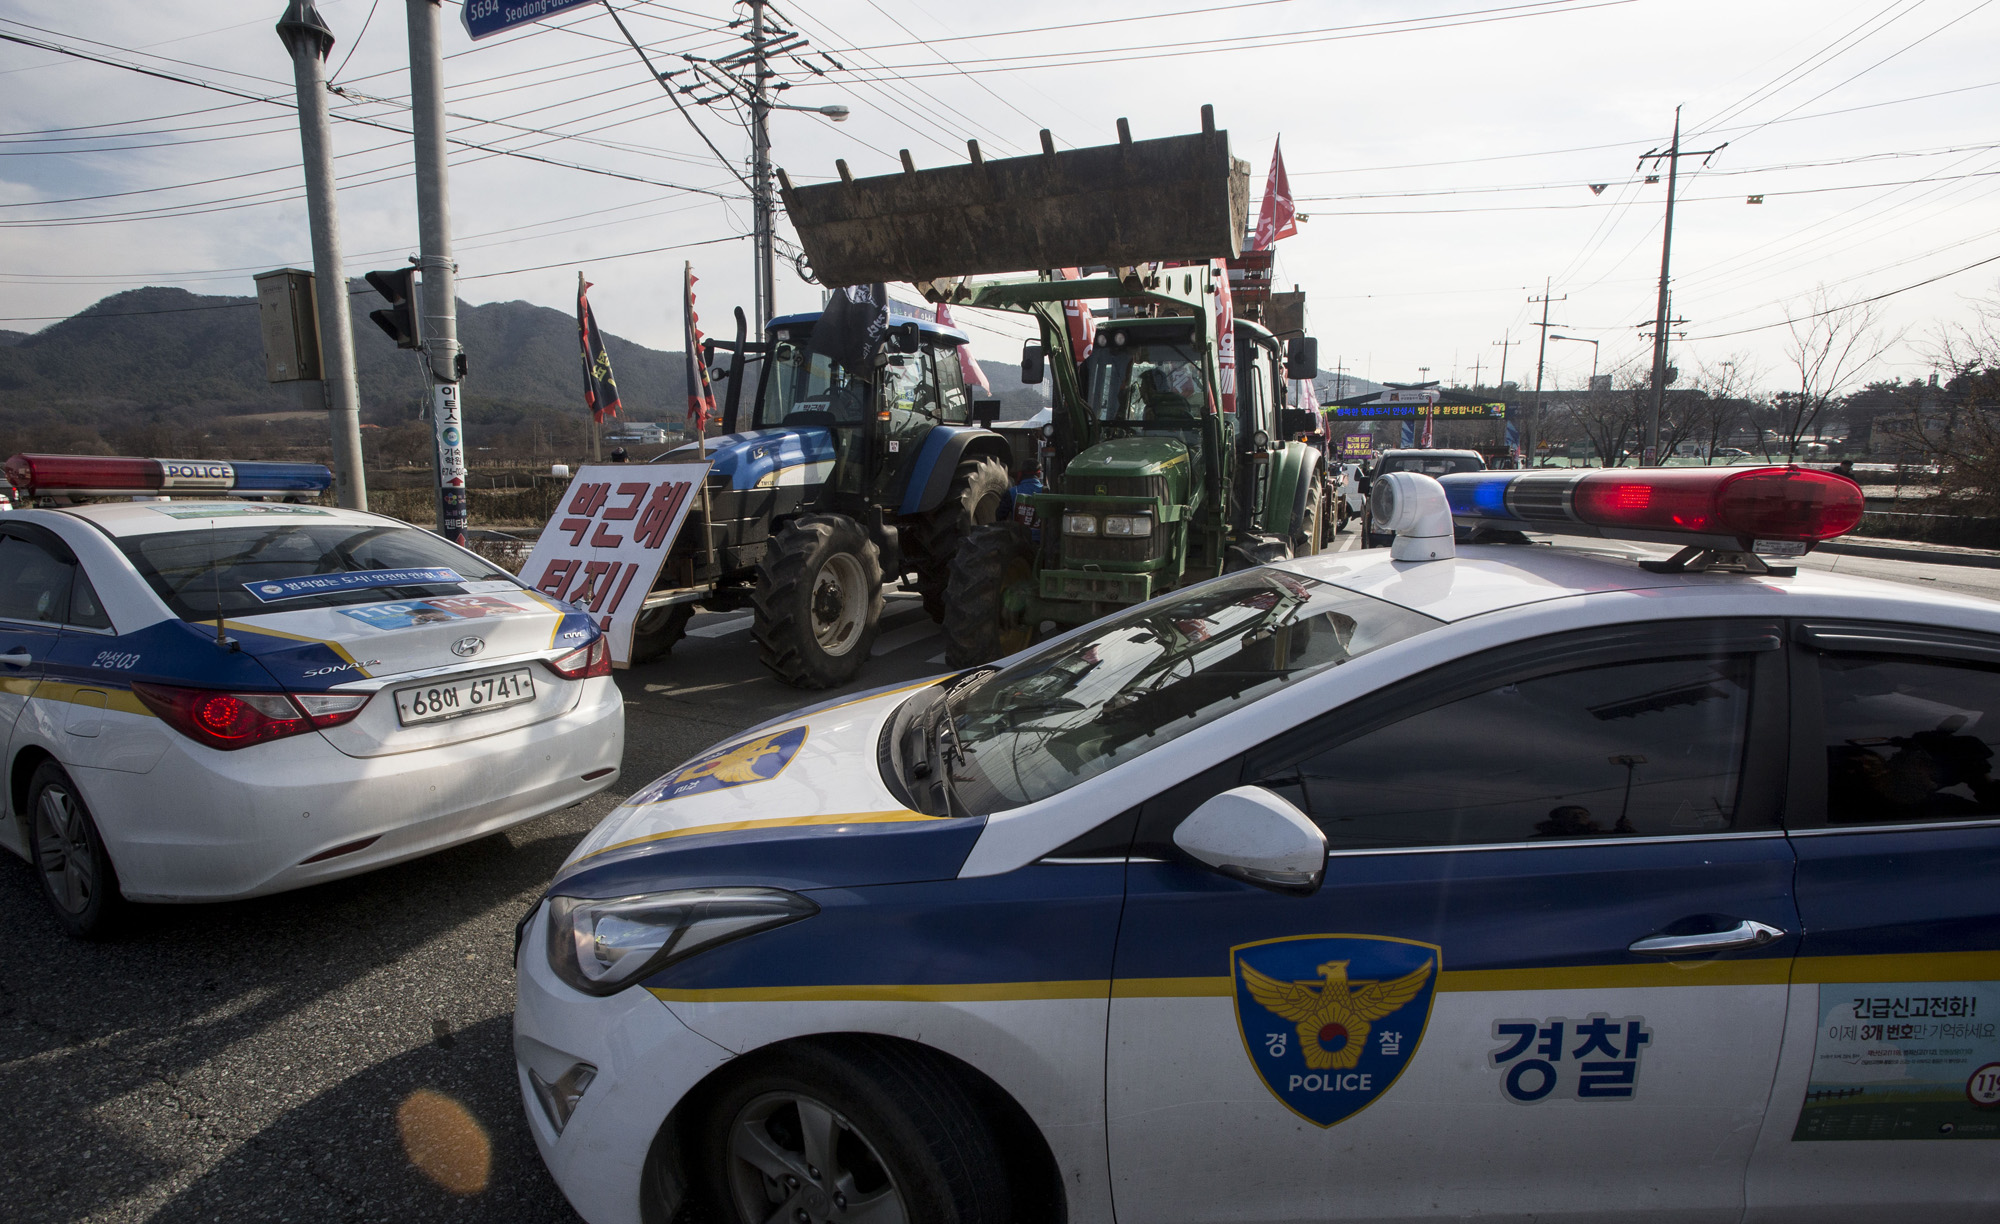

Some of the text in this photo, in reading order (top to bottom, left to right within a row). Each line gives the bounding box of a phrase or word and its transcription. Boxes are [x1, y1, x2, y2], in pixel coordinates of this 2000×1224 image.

[471, 0, 499, 21] 5694
[505, 0, 573, 22] Seodong-da
[441, 387, 458, 424] 이투스
[1392, 407, 1415, 416] 안성시
[1443, 405, 1485, 415] 환영합니다.
[445, 457, 462, 465] 학원
[168, 466, 230, 478] POLICE
[559, 481, 692, 549] 박근혜
[284, 578, 340, 591] 범죄없는
[341, 575, 371, 584] 도시!
[348, 605, 412, 618] 110
[430, 598, 487, 608] 112
[91, 651, 140, 669] 안성03
[302, 660, 381, 678] SONATA
[413, 687, 460, 715] 68어
[470, 675, 520, 704] 6741
[1852, 996, 1977, 1019] 긴급신고전화!
[1829, 1023, 1995, 1041] 이제 3개 번호만 기억하세요
[1265, 1031, 1403, 1058] 경 찰
[1494, 1017, 1649, 1101] 경찰
[1288, 1073, 1372, 1092] POLICE
